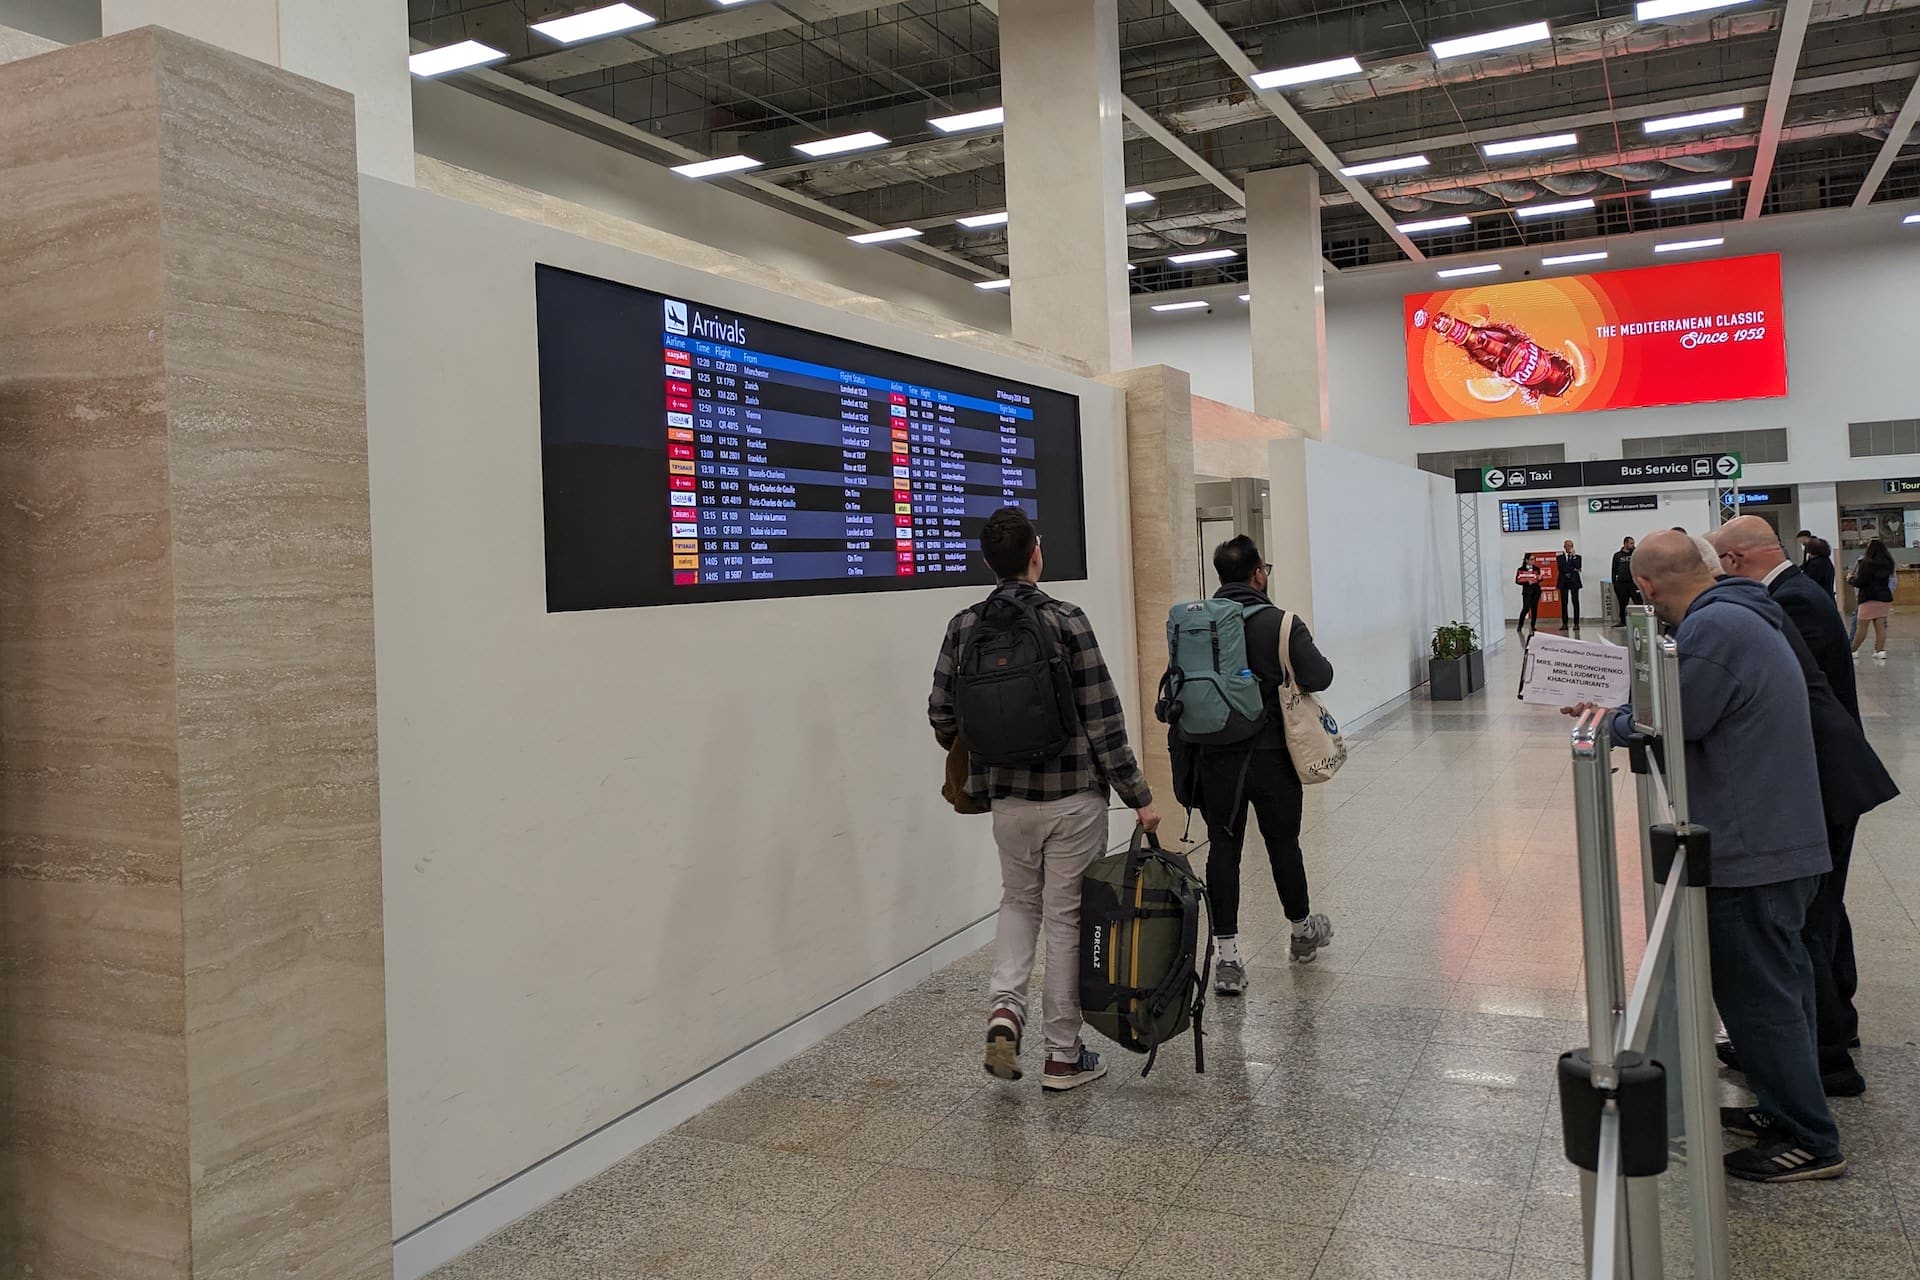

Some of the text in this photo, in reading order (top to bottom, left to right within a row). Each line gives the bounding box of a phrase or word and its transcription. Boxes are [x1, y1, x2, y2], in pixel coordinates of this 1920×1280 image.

[692, 311, 745, 344] Arrivals
[1596, 311, 1765, 338] THE MEDITERRANEAN CLASSIC
[1680, 327, 1765, 349] Since 1952
[665, 335, 865, 384] Airline Time Flight From Flight Status
[666, 350, 687, 361] easyJet
[696, 356, 710, 367] 12:20
[715, 360, 724, 369] EZY
[725, 361, 737, 372] 2273
[743, 365, 769, 378] Manchester
[697, 372, 711, 382] 12:25
[716, 375, 723, 384] LX
[698, 387, 711, 397] 12:25
[908, 385, 917, 395] Time
[698, 403, 712, 413] 12:50
[699, 418, 713, 428] 12:50
[699, 433, 713, 443] 13:00
[718, 436, 726, 445] LH
[746, 439, 766, 449] Frankfurt
[700, 449, 714, 458] 13:00
[747, 454, 767, 463] Frankfurt
[701, 464, 714, 473] 13:10
[720, 466, 726, 474] FR
[1529, 470, 1552, 481] Taxi
[1621, 463, 1688, 476] Bus Service
[701, 480, 715, 489] 13:15
[851, 489, 860, 497] Time
[702, 495, 716, 504] 13:15
[851, 502, 860, 510] Time
[702, 511, 716, 519] 13:15
[721, 511, 728, 520] EK
[750, 512, 762, 520] Dubai
[703, 526, 717, 534] 13:15
[750, 527, 762, 535] Dubai
[704, 542, 717, 550] 13:45
[722, 542, 729, 550] FR
[751, 542, 767, 550] Catania
[704, 557, 718, 565] 14:05
[723, 557, 730, 565] VY
[751, 556, 772, 564] Barcelona
[847, 554, 853, 562] On
[705, 572, 718, 581] 14:05
[725, 571, 730, 579] IB
[752, 570, 773, 579] Barcelona
[847, 567, 853, 575] On
[854, 567, 863, 575] Time
[1094, 926, 1102, 969] FORCLAZ
